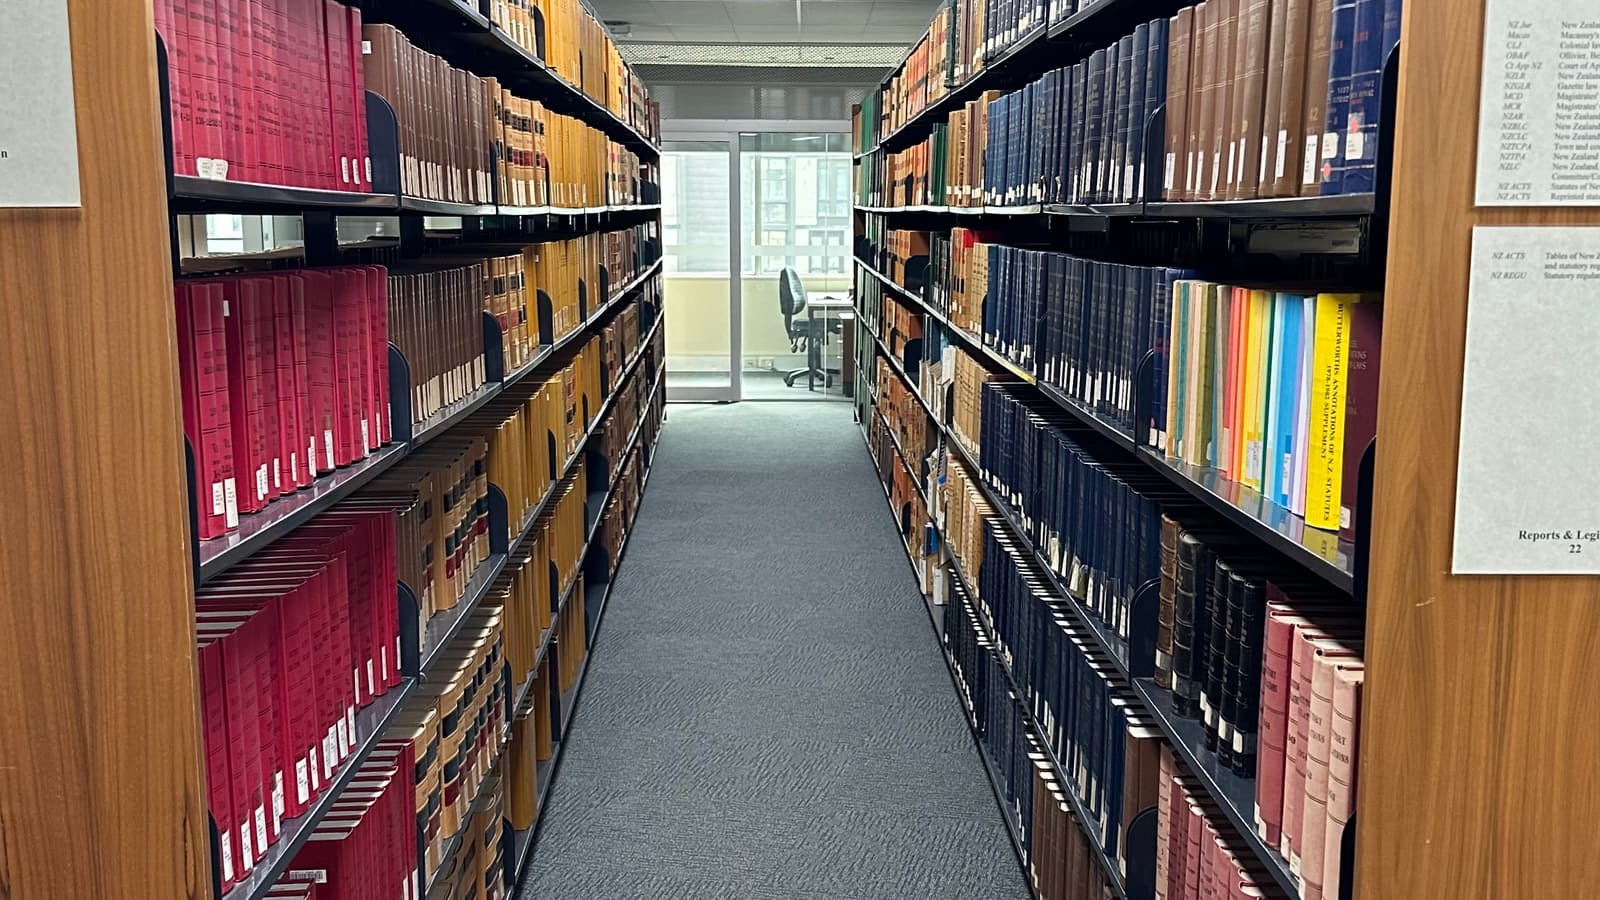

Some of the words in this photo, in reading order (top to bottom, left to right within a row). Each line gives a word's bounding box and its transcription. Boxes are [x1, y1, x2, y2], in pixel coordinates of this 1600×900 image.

[1561, 21, 1578, 29] New
[1558, 61, 1578, 69] Court
[1580, 61, 1589, 69] of
[1558, 71, 1574, 79] New
[1557, 82, 1584, 90] Gazette
[1585, 82, 1598, 90] law
[1555, 112, 1572, 120] New
[1555, 122, 1571, 130] New
[1554, 132, 1570, 140] New
[1575, 142, 1588, 150] and
[1553, 152, 1569, 160] New
[1552, 162, 1569, 170] New
[1551, 182, 1578, 190] Statutes
[1580, 182, 1589, 190] of
[1551, 192, 1584, 201] Reprinted
[1505, 252, 1526, 260] ACTS
[1545, 252, 1568, 260] Tables
[1569, 252, 1578, 260] of
[1579, 252, 1594, 260] New
[1559, 263, 1587, 271] statutory
[1544, 272, 1574, 280] Statutory
[1334, 303, 1344, 375] BUTTERWORTHS
[1329, 379, 1338, 440] ANNOTATIONS
[1321, 402, 1329, 459] SUPPLEMENT
[1328, 444, 1335, 455] OF
[1323, 477, 1332, 521] STATUTES
[1518, 530, 1561, 542] Reports
[1563, 530, 1573, 540] &
[1569, 544, 1582, 554] 22
